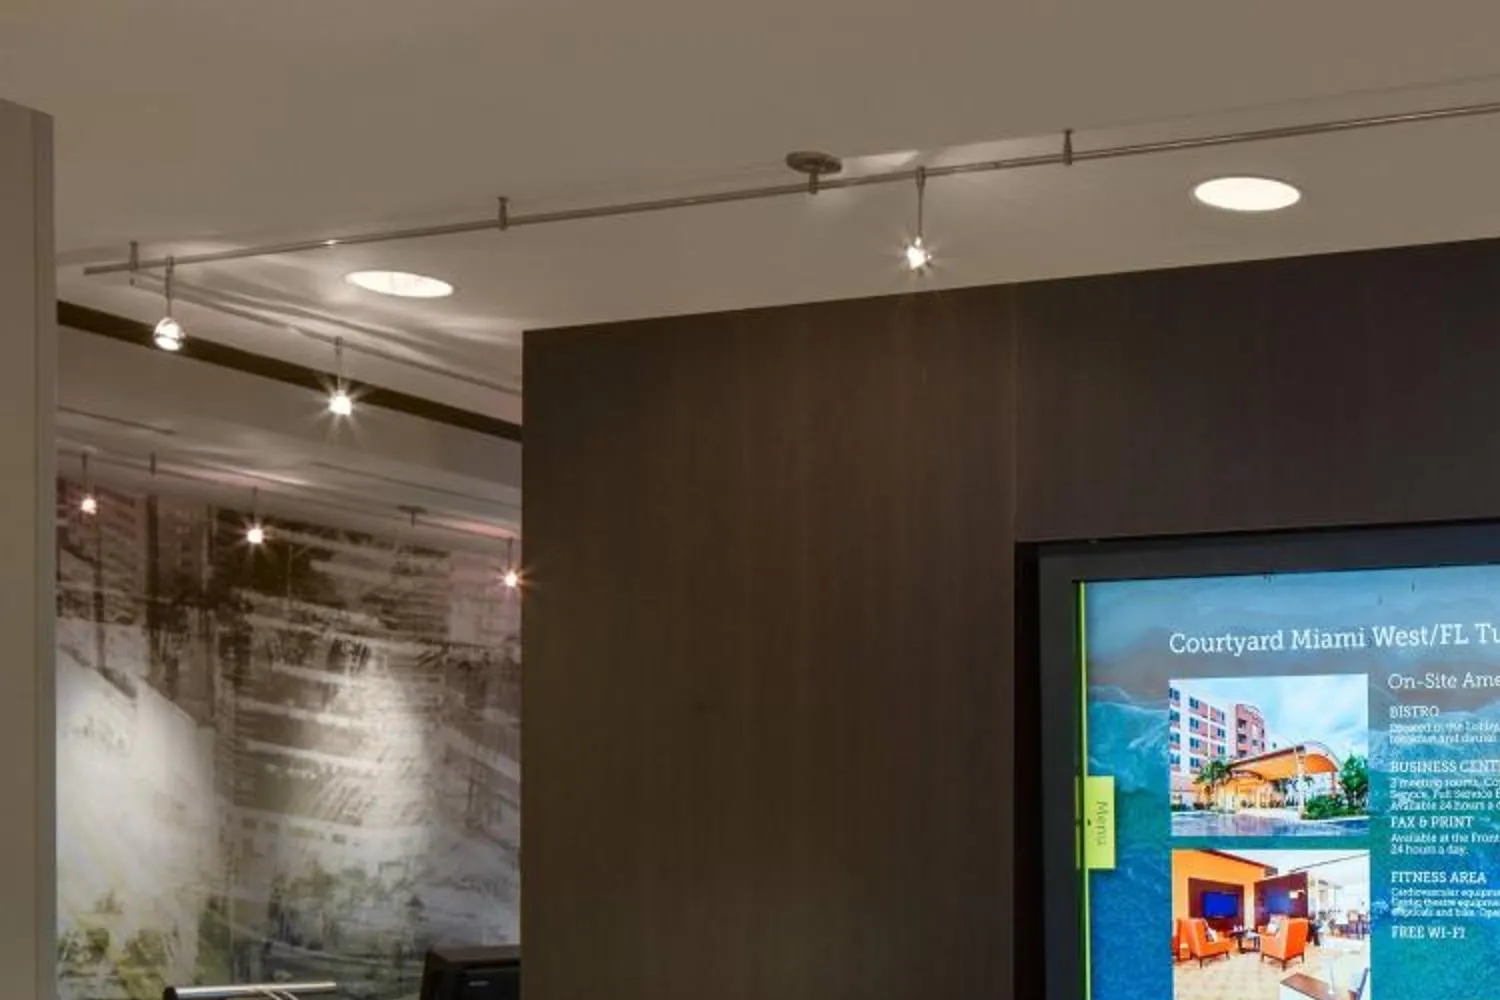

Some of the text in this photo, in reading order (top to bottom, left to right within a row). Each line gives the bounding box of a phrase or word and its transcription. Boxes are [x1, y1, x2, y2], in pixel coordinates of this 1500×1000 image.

[1169, 630, 1283, 657] Courtyard
[1289, 627, 1366, 650] Miami
[1370, 624, 1469, 648] West/FL
[1388, 673, 1457, 690] On-Site
[1389, 705, 1440, 719] BISTRO
[1390, 760, 1457, 773] BUSINESS
[1454, 801, 1486, 811] hours
[1096, 800, 1108, 846] Menu
[1391, 816, 1474, 828] FAX & PRINT
[1391, 834, 1437, 843] Available
[1440, 834, 1449, 843] at
[1452, 833, 1468, 843] the
[1471, 833, 1499, 844] Front
[1390, 844, 1403, 855] 24
[1405, 844, 1435, 854] hours
[1391, 871, 1487, 884] FITNESS AREA
[1391, 926, 1465, 939] FREE WI-FI
